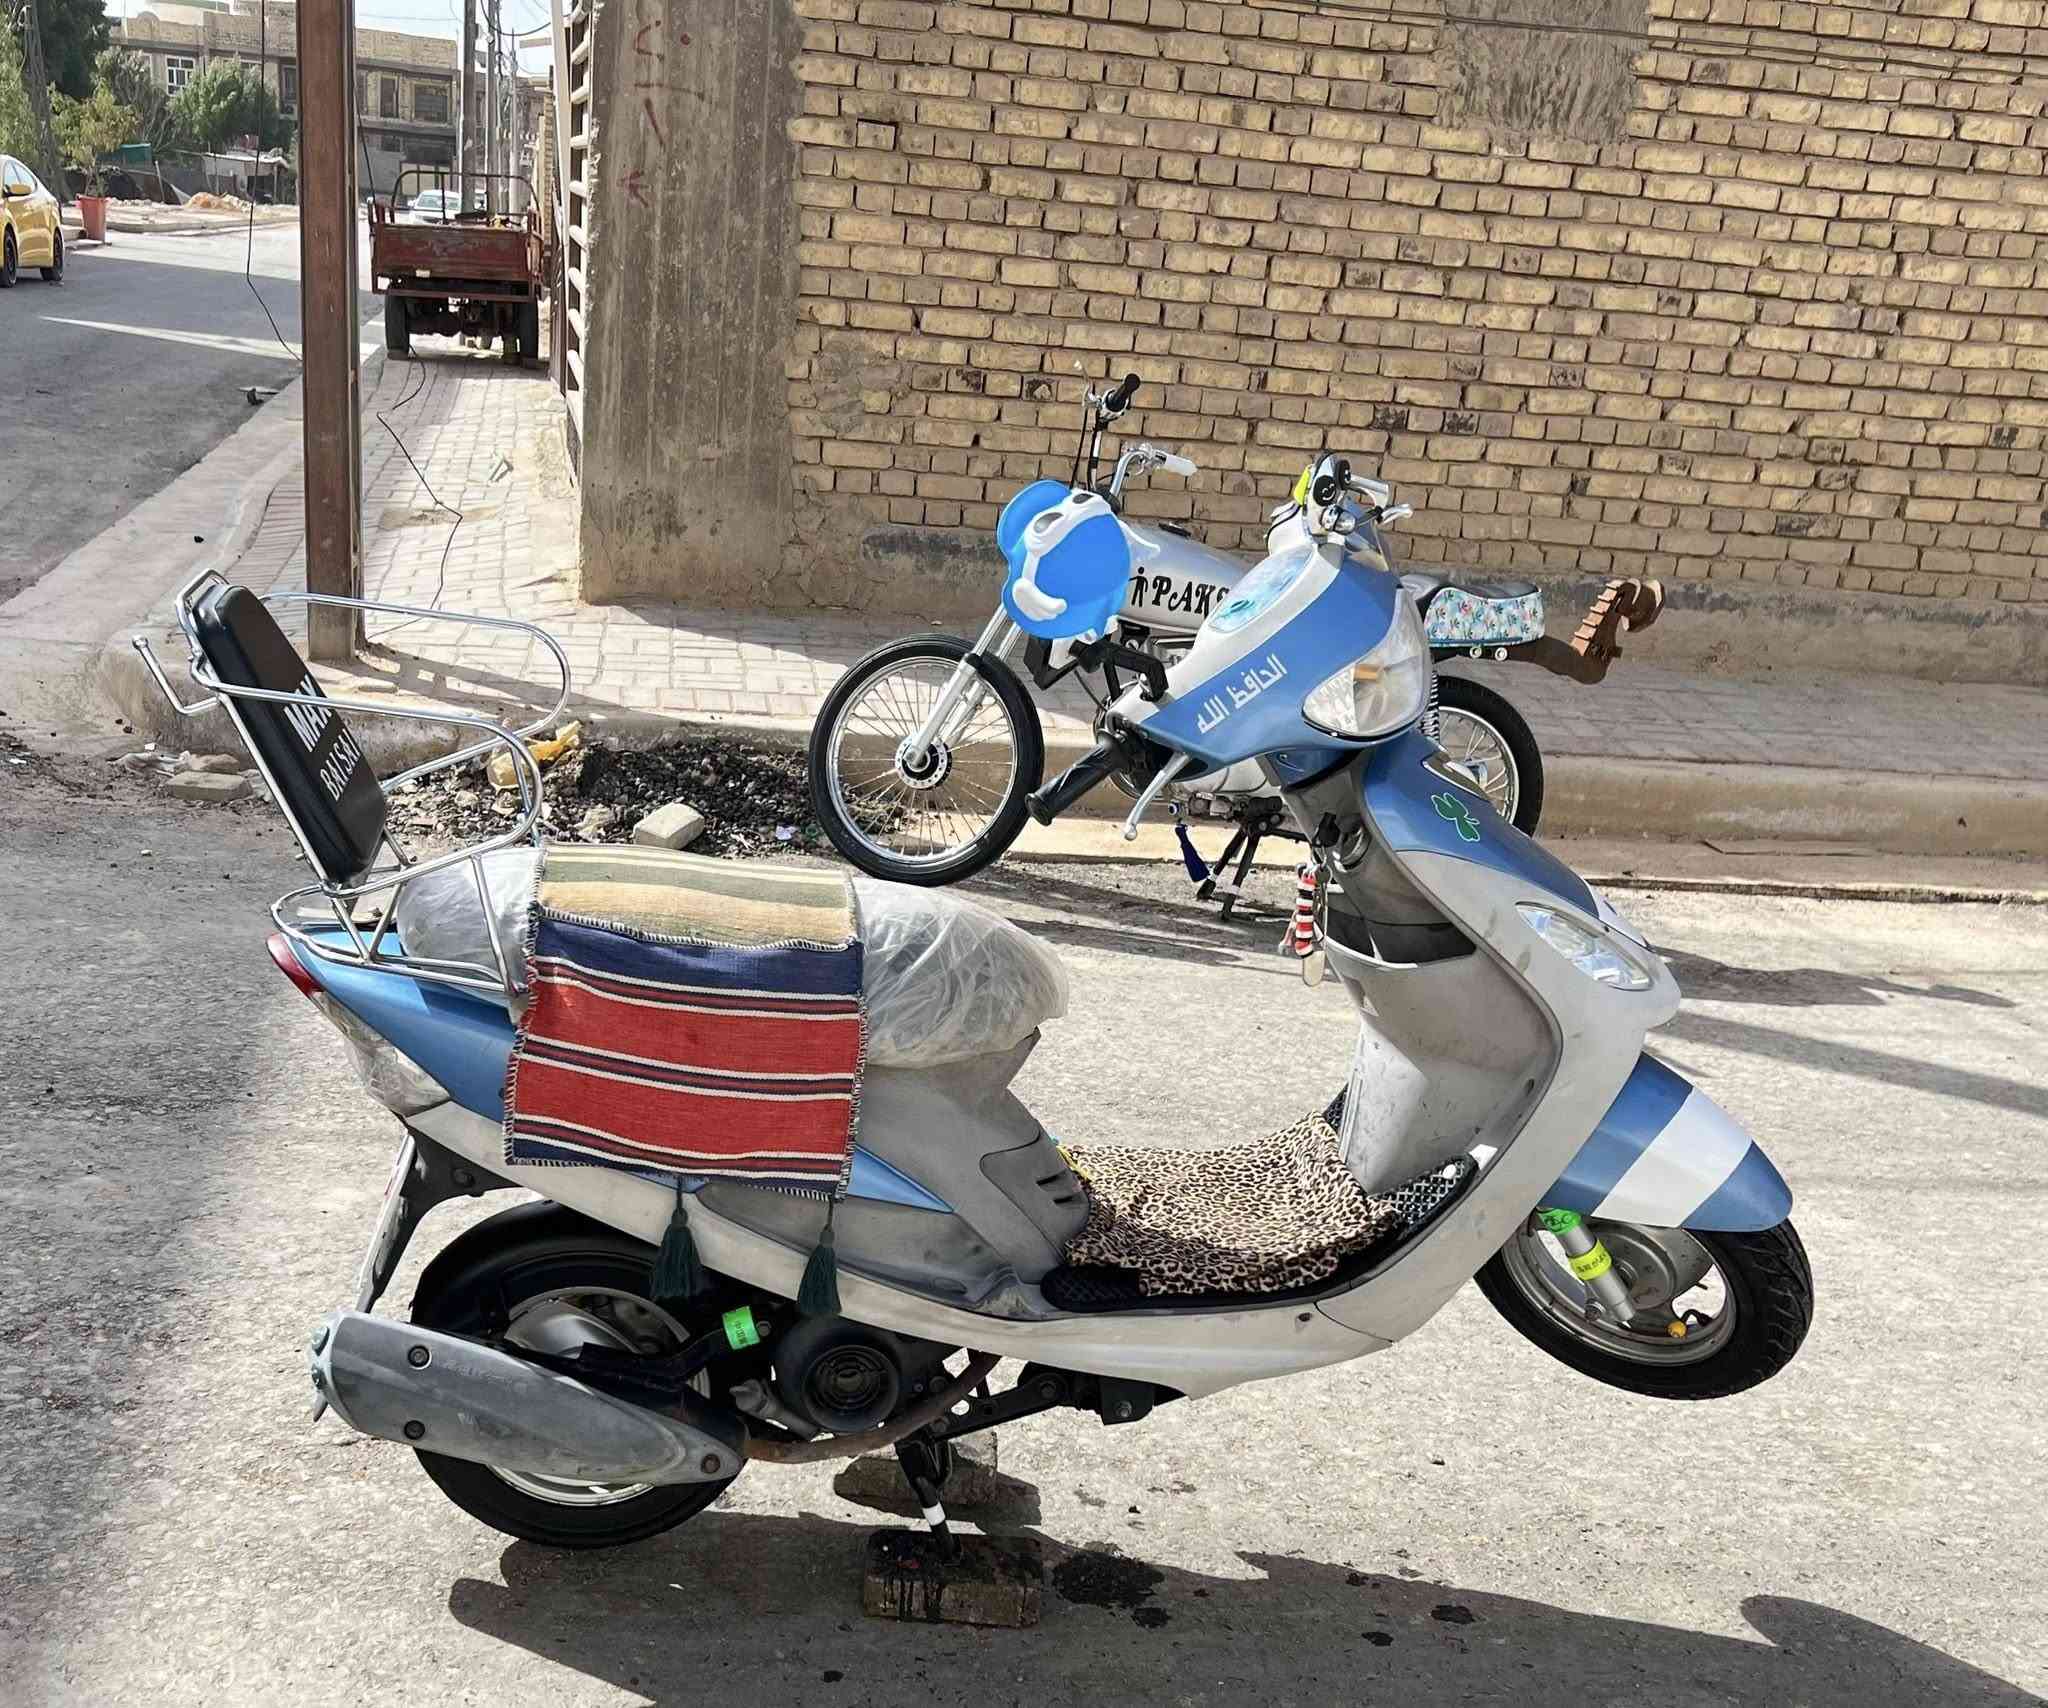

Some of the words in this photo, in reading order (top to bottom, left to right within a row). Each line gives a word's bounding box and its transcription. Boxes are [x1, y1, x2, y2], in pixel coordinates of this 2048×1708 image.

[1226, 653, 1288, 710] الحافظ
[283, 674, 332, 753] MAX
[1197, 694, 1230, 734] الله
